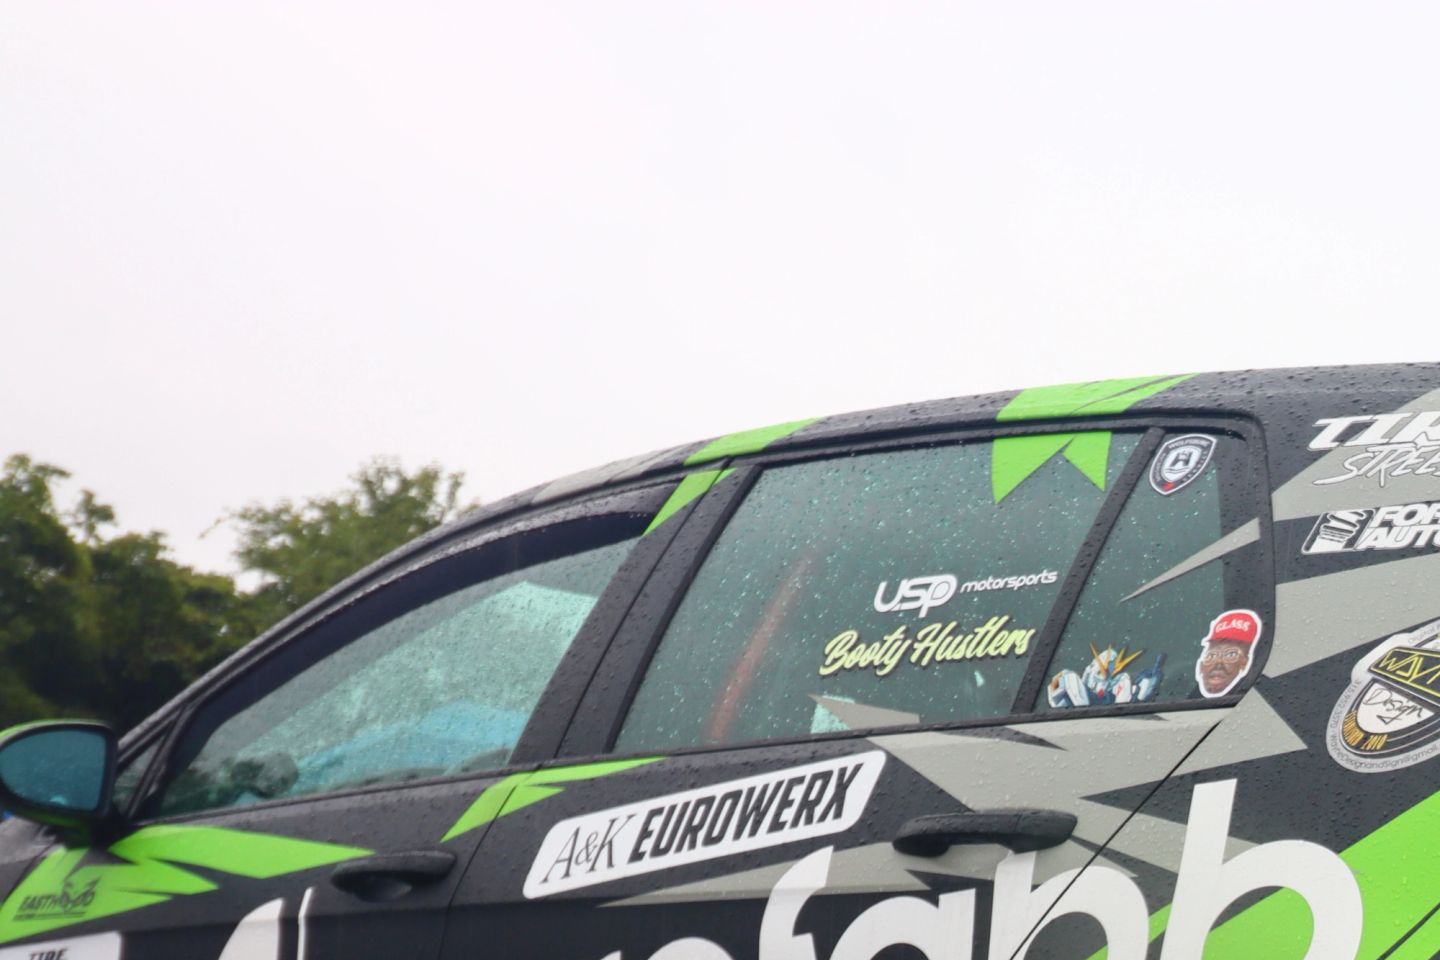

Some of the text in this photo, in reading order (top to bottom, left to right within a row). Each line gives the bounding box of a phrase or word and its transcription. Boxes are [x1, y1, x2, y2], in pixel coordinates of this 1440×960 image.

[959, 569, 1059, 594] motorsports
[818, 614, 1037, 677] Booty Hustlers
[1215, 619, 1251, 633] GLASS
[539, 762, 864, 886] A&K EUROWERX
